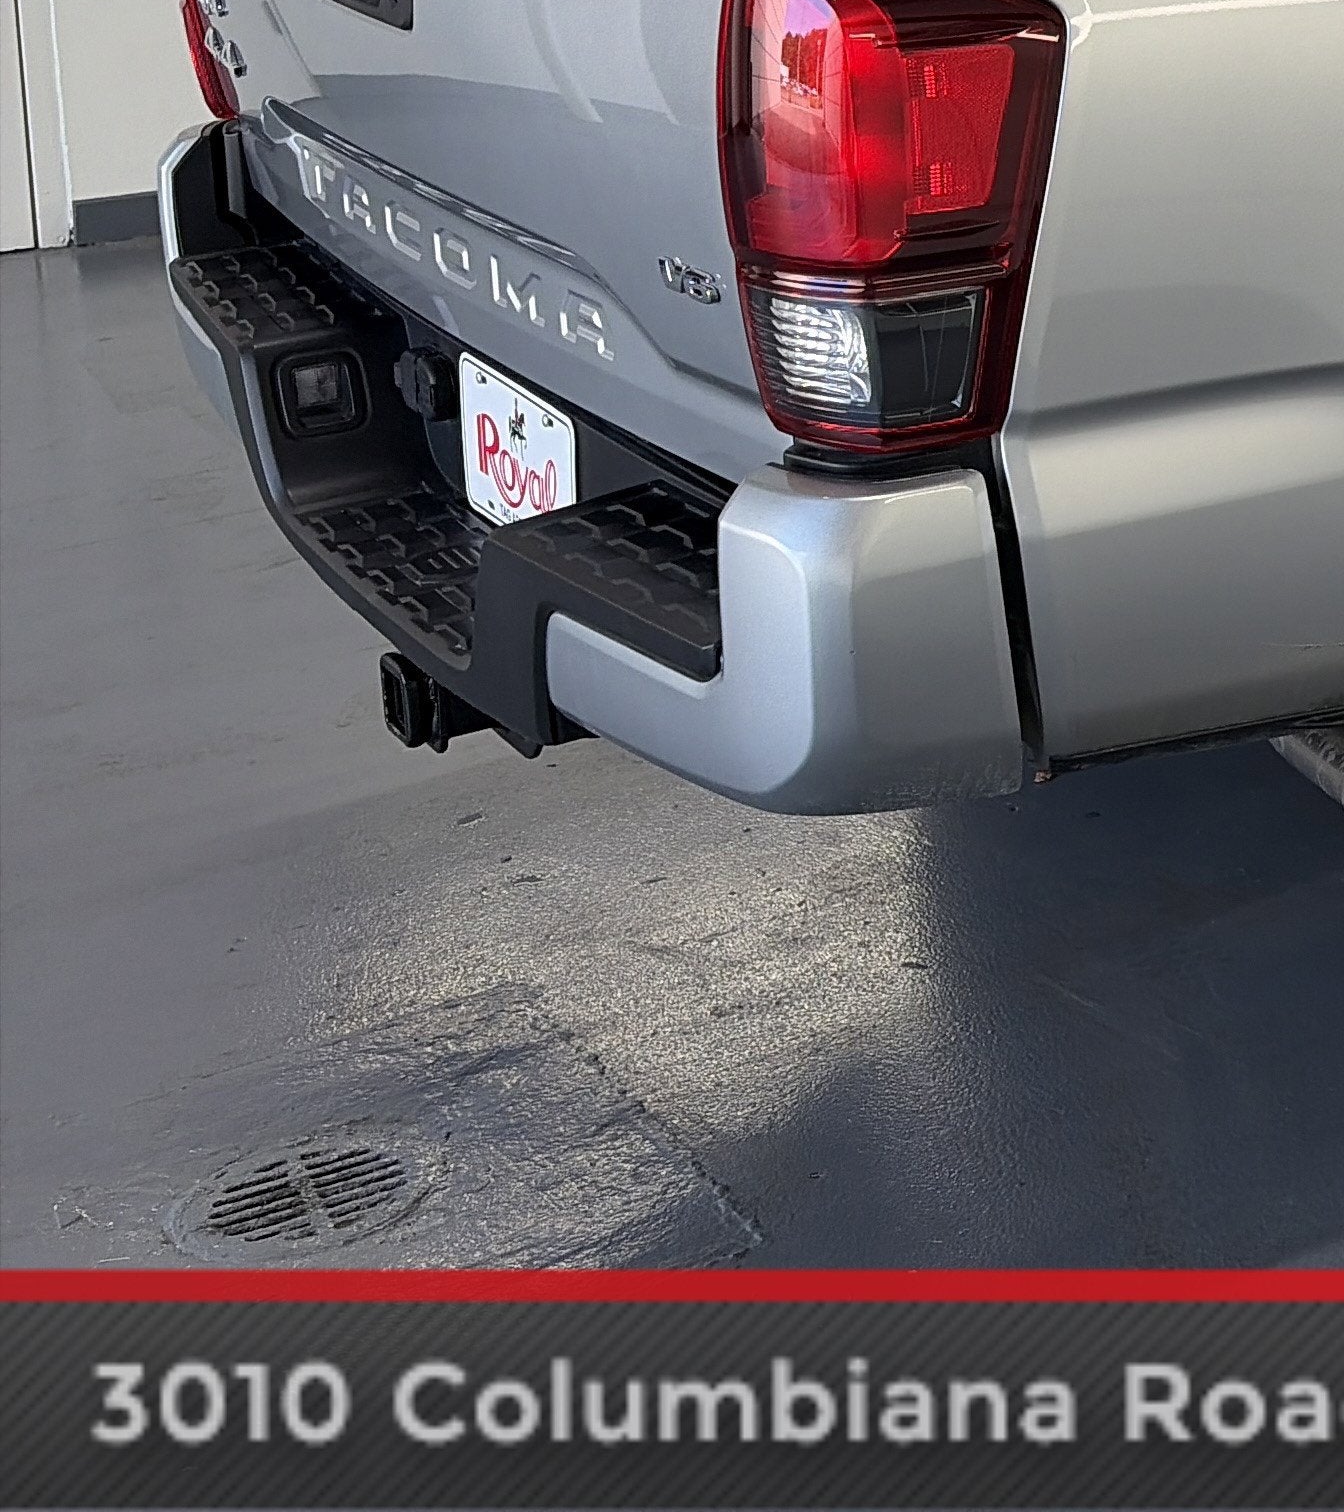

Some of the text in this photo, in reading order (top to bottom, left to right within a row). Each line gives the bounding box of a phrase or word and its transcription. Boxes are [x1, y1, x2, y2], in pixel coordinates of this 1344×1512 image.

[302, 144, 616, 362] TACOMA
[658, 254, 722, 305] V6
[476, 412, 558, 515] Royal
